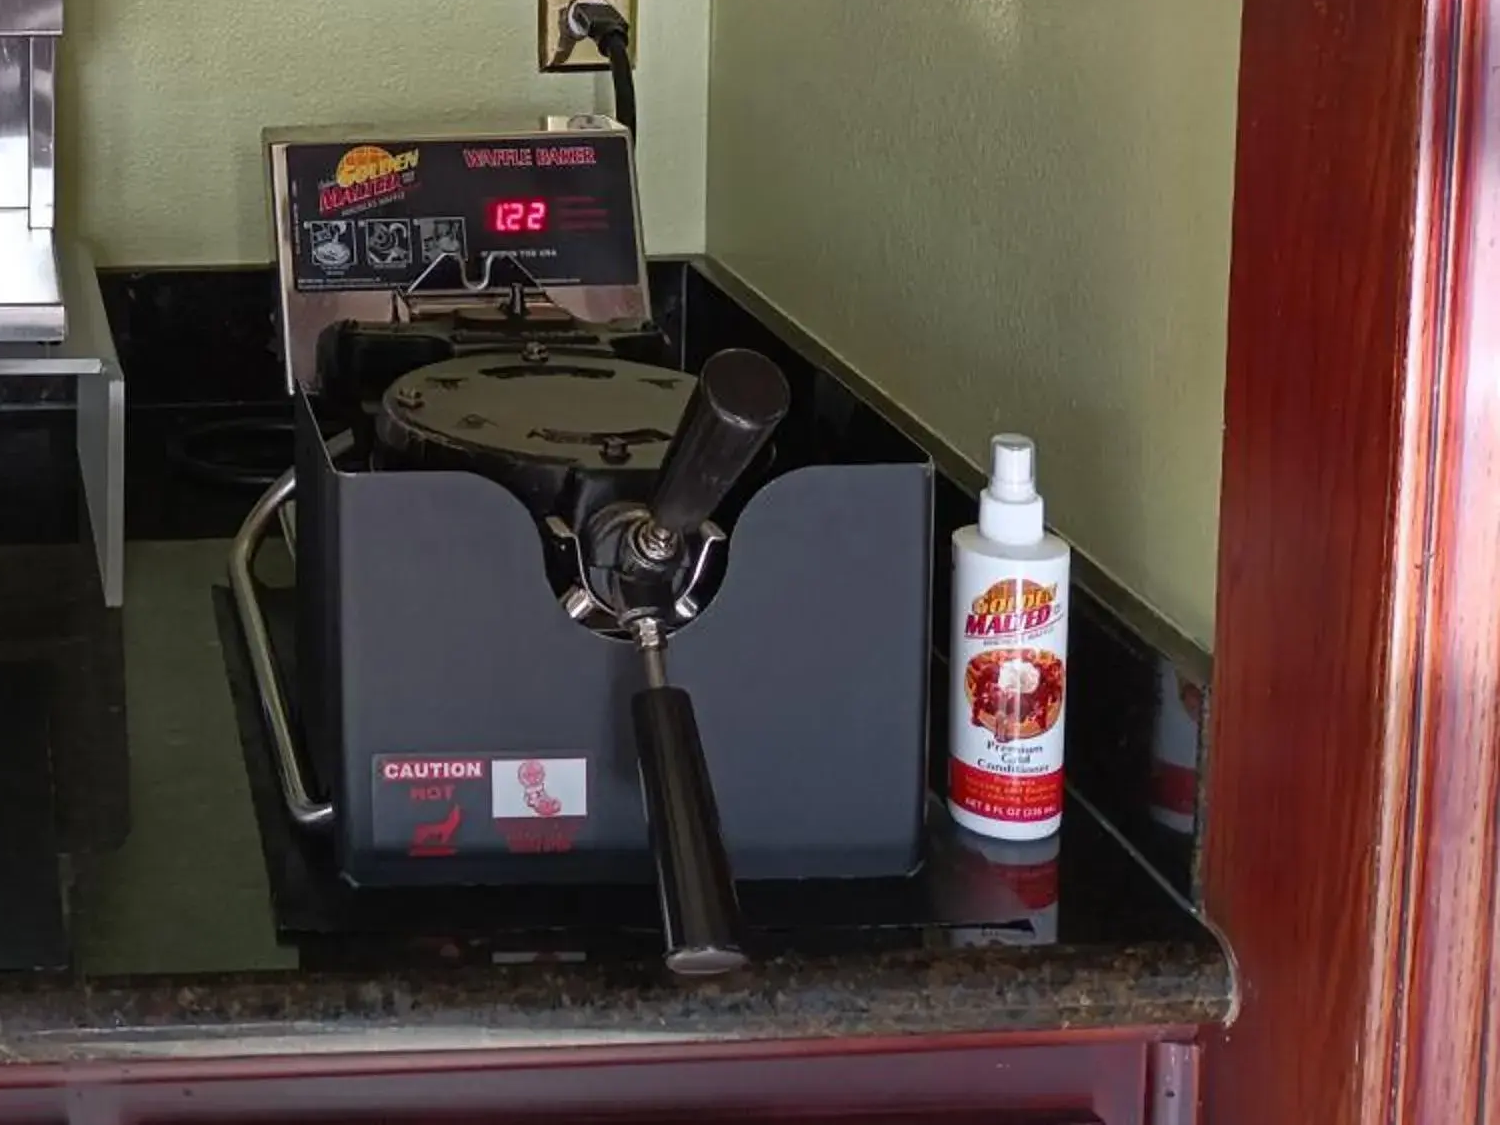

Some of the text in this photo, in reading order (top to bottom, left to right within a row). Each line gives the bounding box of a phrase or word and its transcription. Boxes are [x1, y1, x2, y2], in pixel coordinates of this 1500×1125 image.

[463, 146, 597, 168] WAFFLE BAKER
[383, 761, 483, 780] CAUTION
[410, 786, 456, 801] HOT
